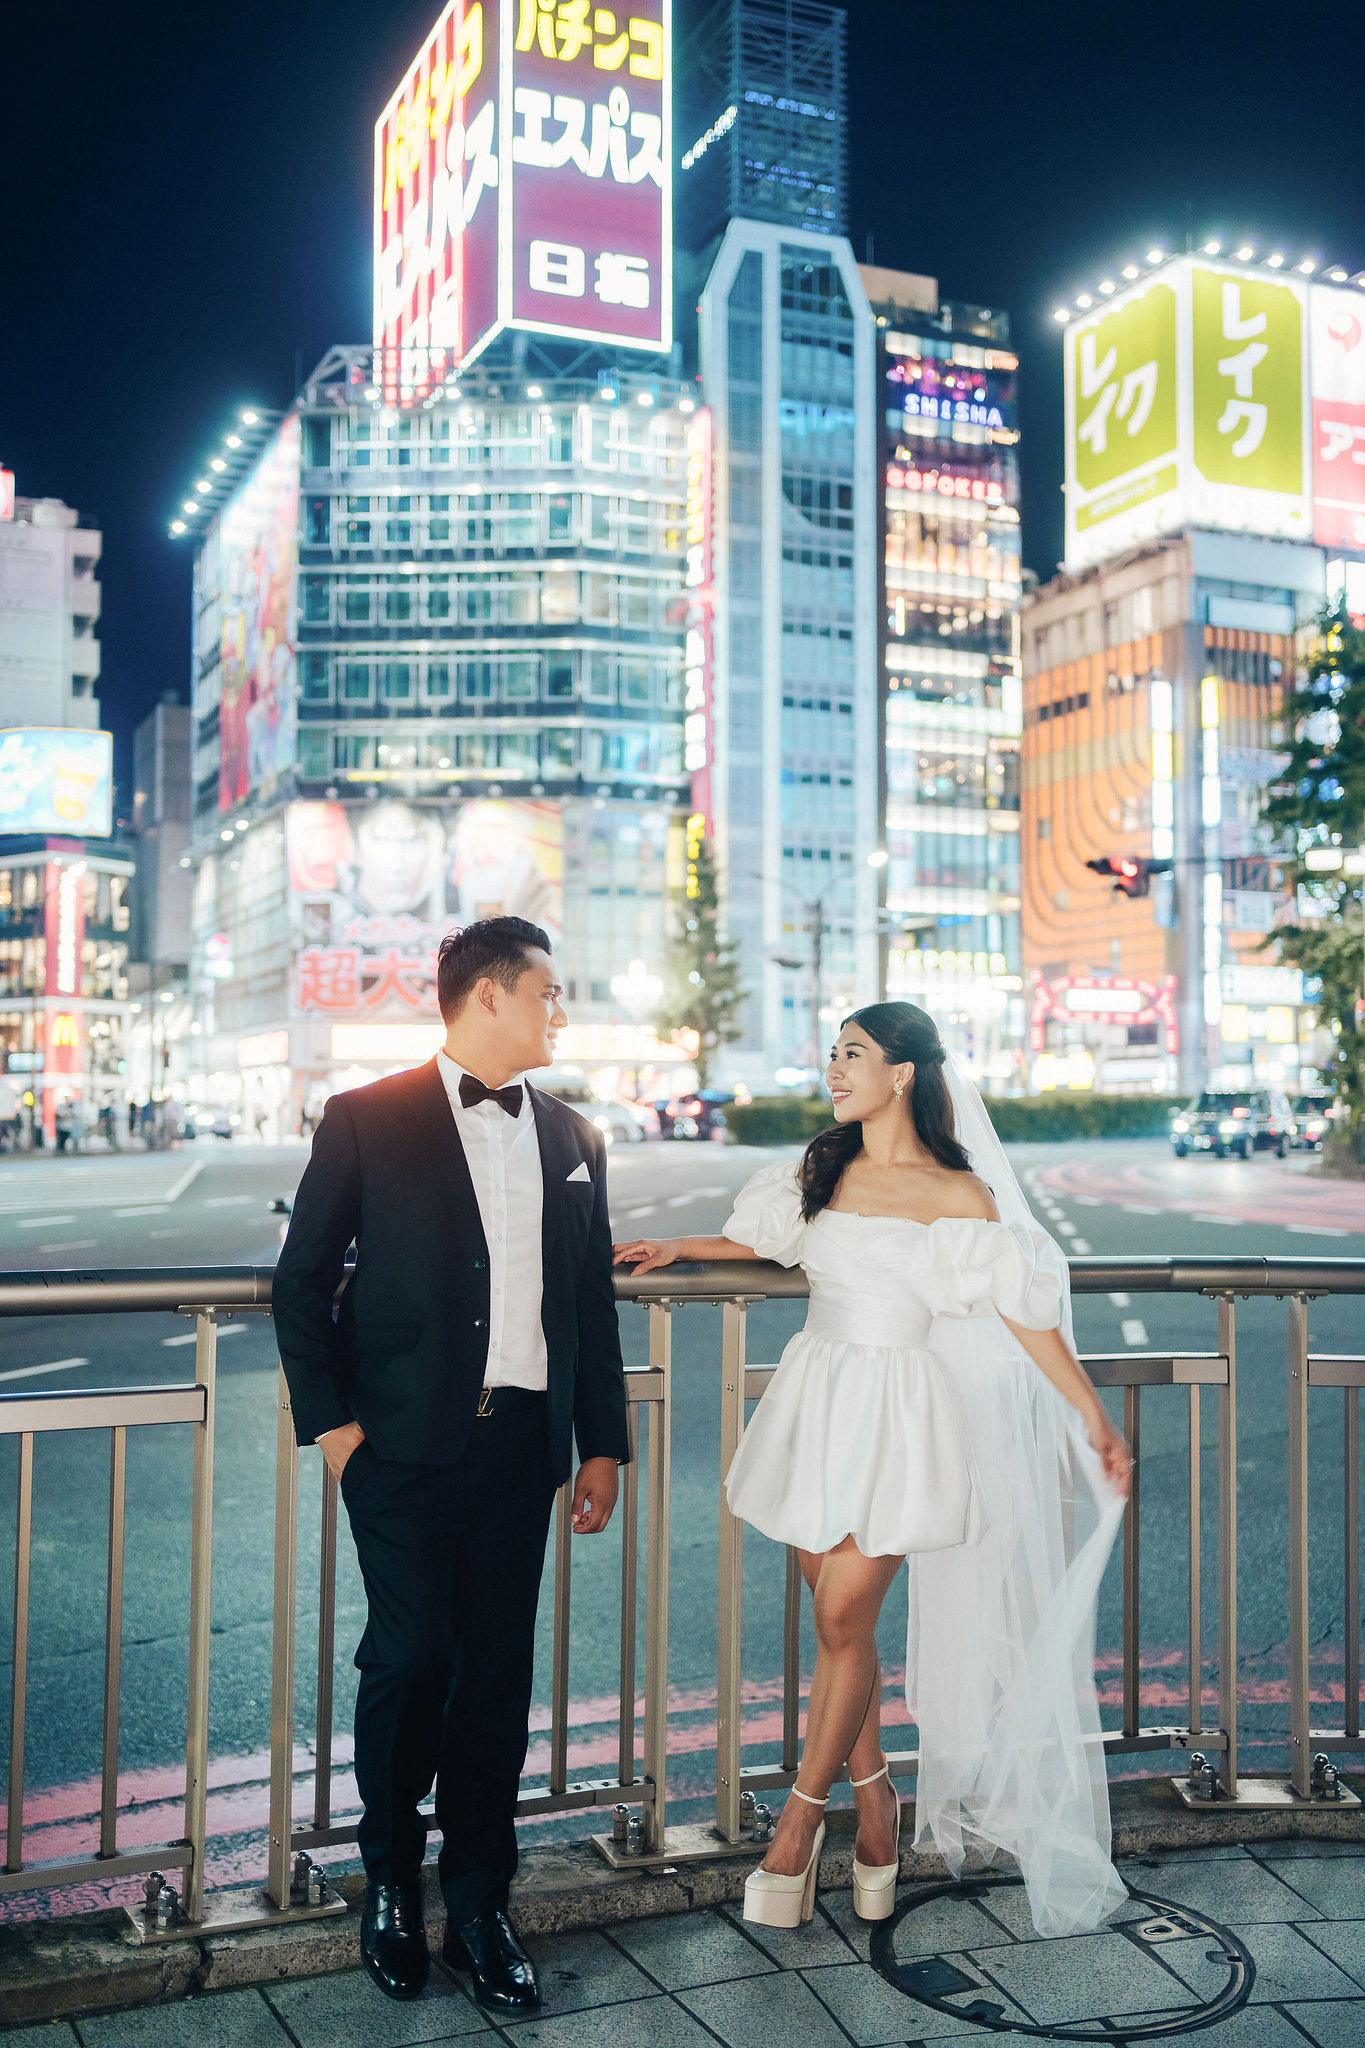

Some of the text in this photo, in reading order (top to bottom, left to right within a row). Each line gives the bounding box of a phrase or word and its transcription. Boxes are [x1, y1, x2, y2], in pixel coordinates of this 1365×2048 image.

[515, 0, 663, 80] パチンコ
[512, 86, 662, 188] エスパス
[903, 392, 1003, 428] SHISHA
[1079, 333, 1158, 455] レイク
[1217, 282, 1268, 458] レイク
